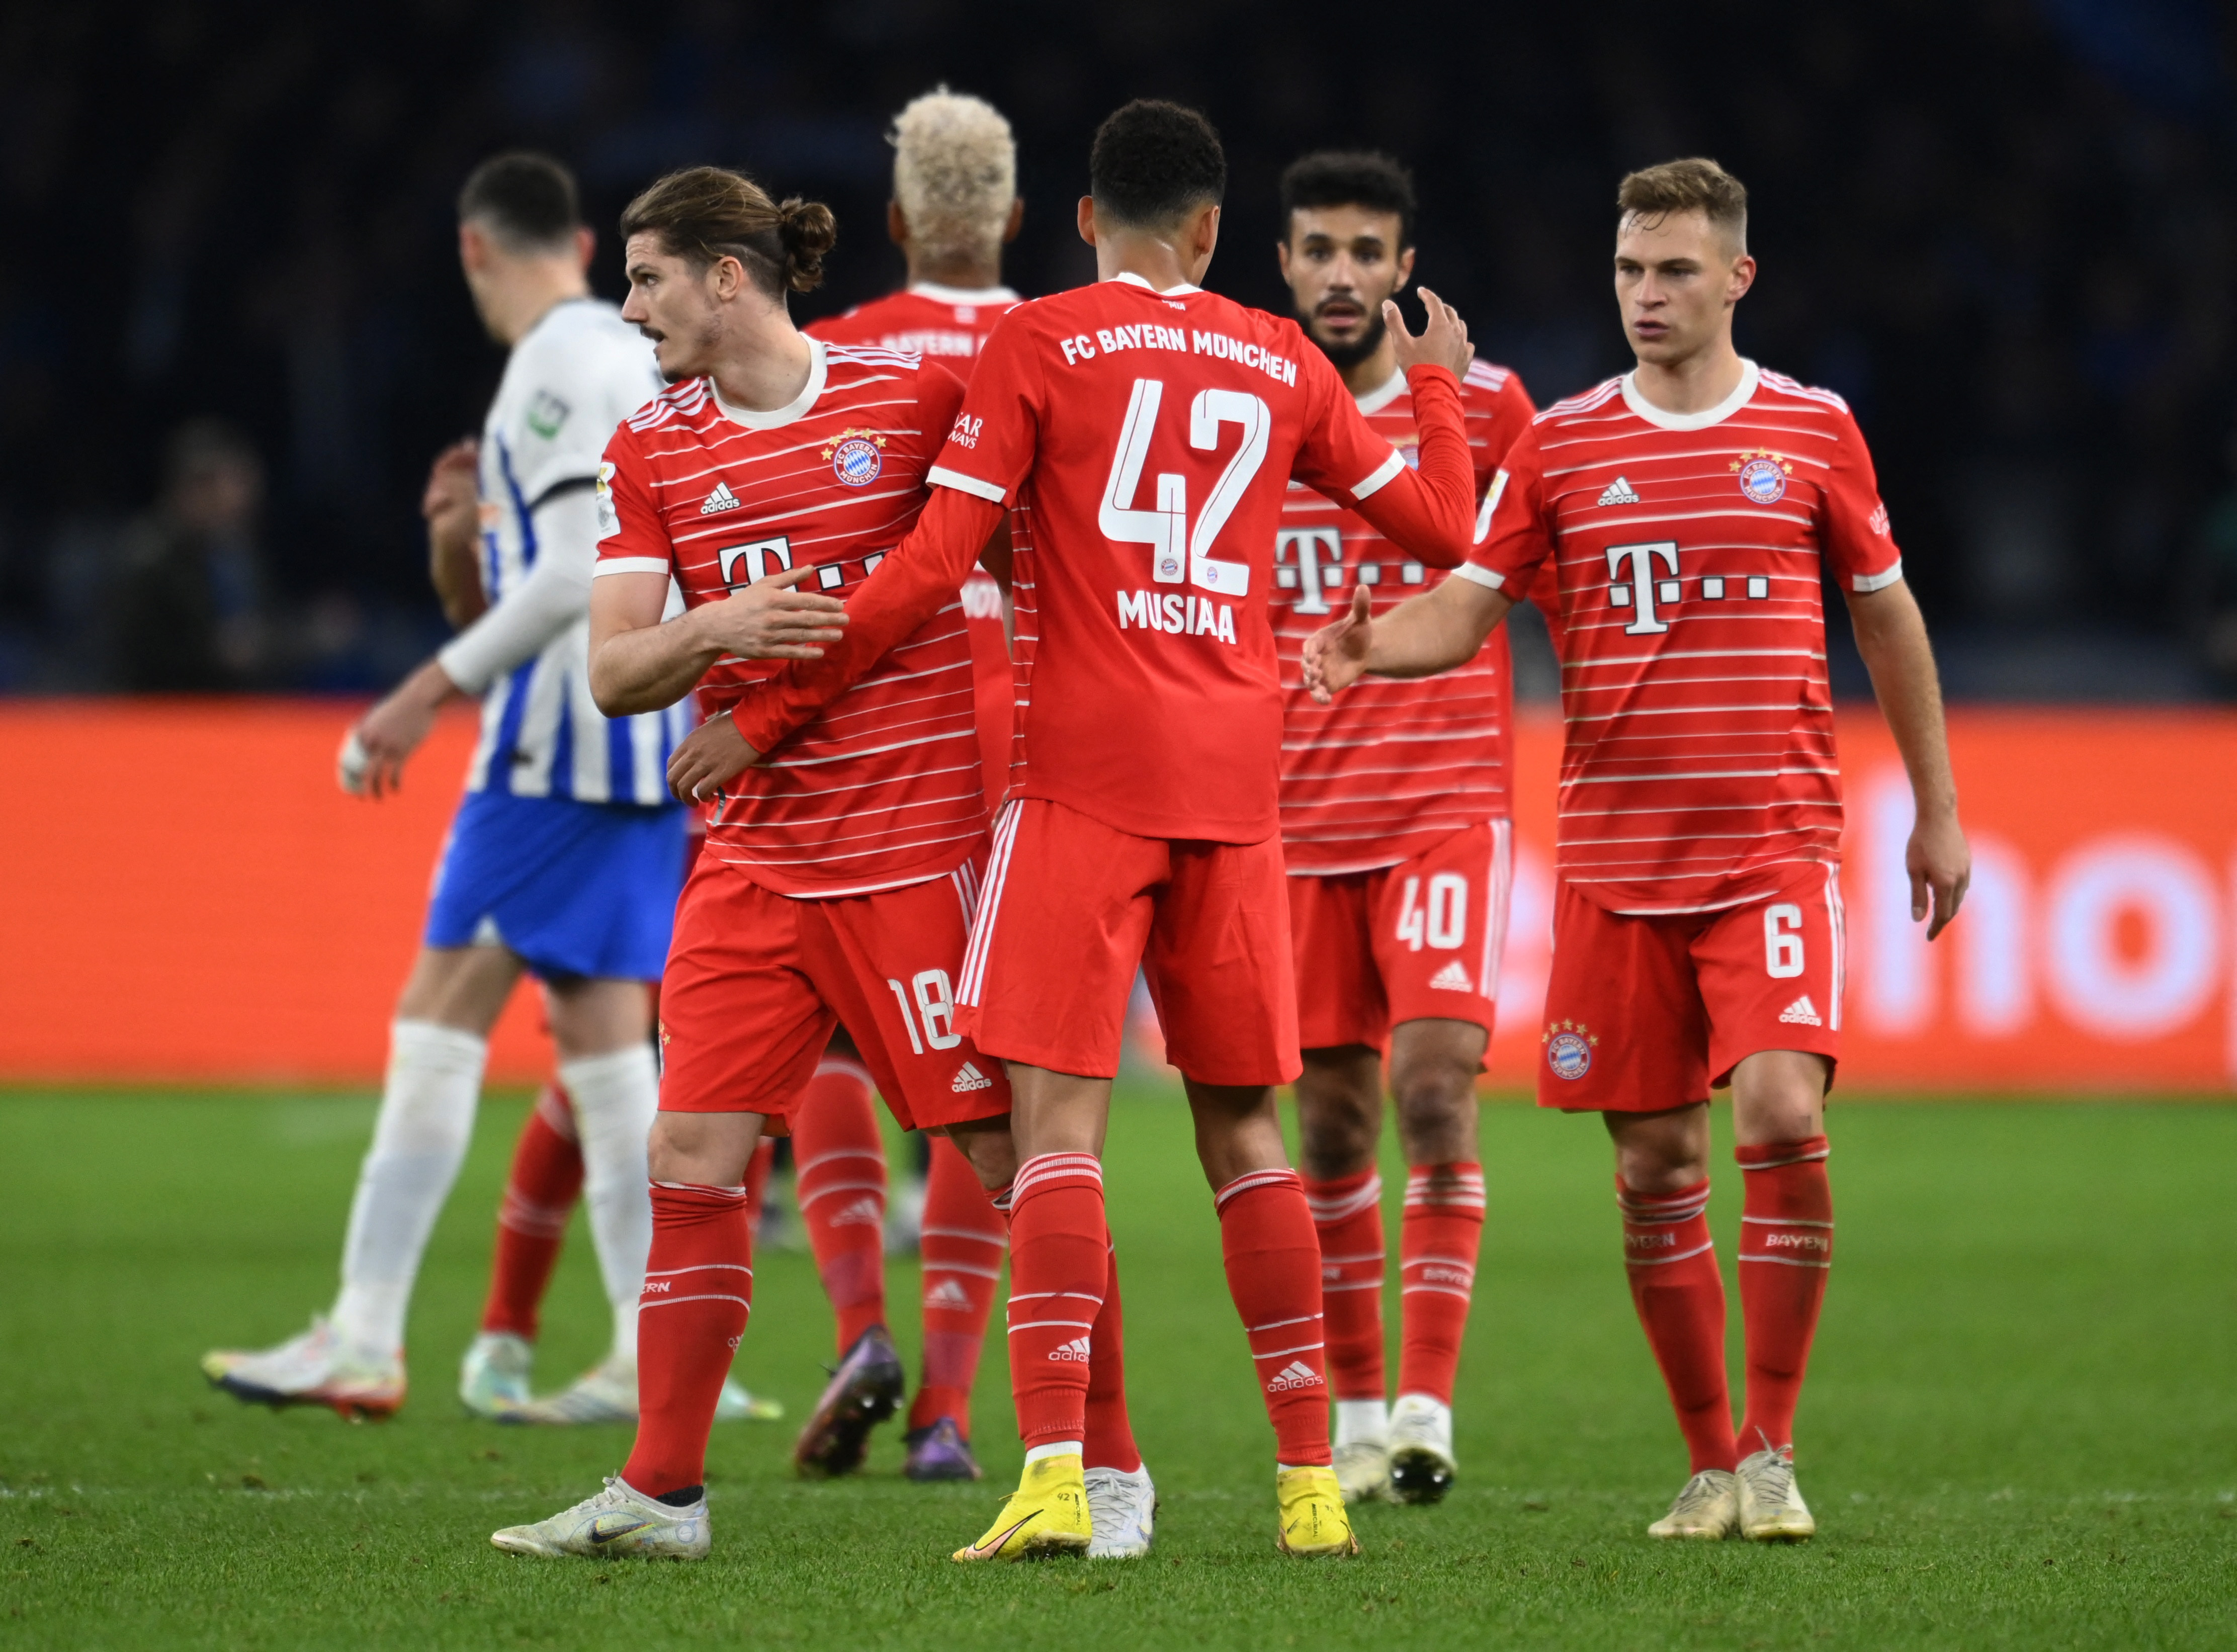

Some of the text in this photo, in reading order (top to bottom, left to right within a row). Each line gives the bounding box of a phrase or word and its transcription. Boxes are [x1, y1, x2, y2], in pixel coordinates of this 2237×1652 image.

[1060, 324, 1298, 388] FC BAYERN MÜNCHEN
[837, 443, 875, 464] FC BAYERN
[1744, 463, 1781, 480] FC BAYERN
[1098, 378, 1271, 597] 42
[700, 498, 740, 514] adidas
[1597, 494, 1640, 506] adidas
[1606, 540, 1681, 635] T
[1117, 589, 1237, 645] MUSIAA
[1396, 873, 1468, 951] 40
[1764, 903, 1804, 979] 6
[887, 969, 962, 1055] 18
[1779, 1013, 1822, 1026] adidas
[1558, 1037, 1586, 1055] BAYERN
[952, 1078, 992, 1093] adidas
[1267, 1375, 1324, 1393] adidas
[1057, 1492, 1070, 1501] 42
